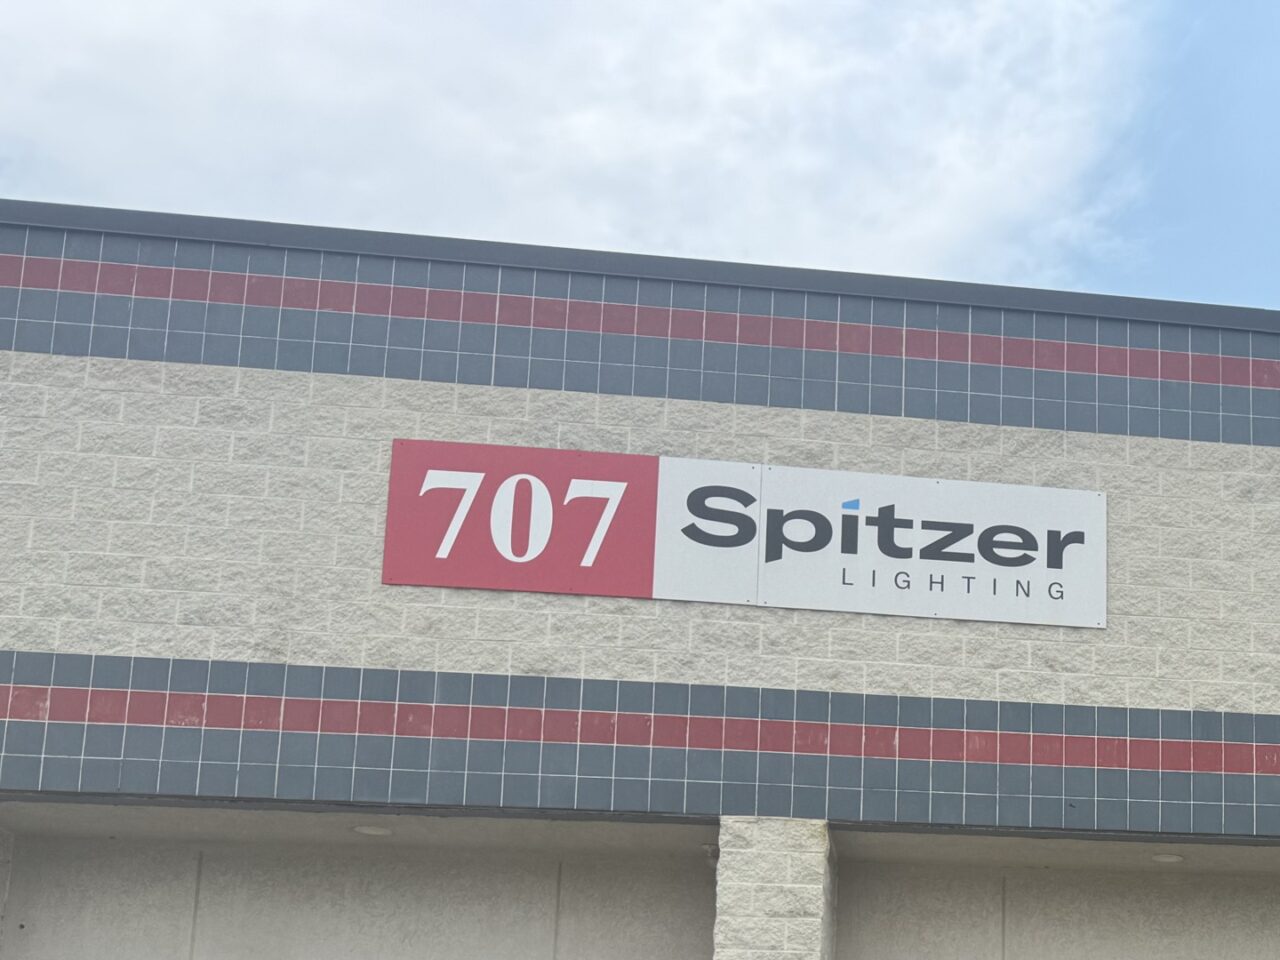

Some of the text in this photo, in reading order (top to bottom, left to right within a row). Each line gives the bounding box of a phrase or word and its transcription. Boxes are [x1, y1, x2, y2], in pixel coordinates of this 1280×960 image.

[418, 468, 628, 568] 707
[680, 484, 1086, 570] Spitzer
[841, 567, 1066, 602] LIGHTING
